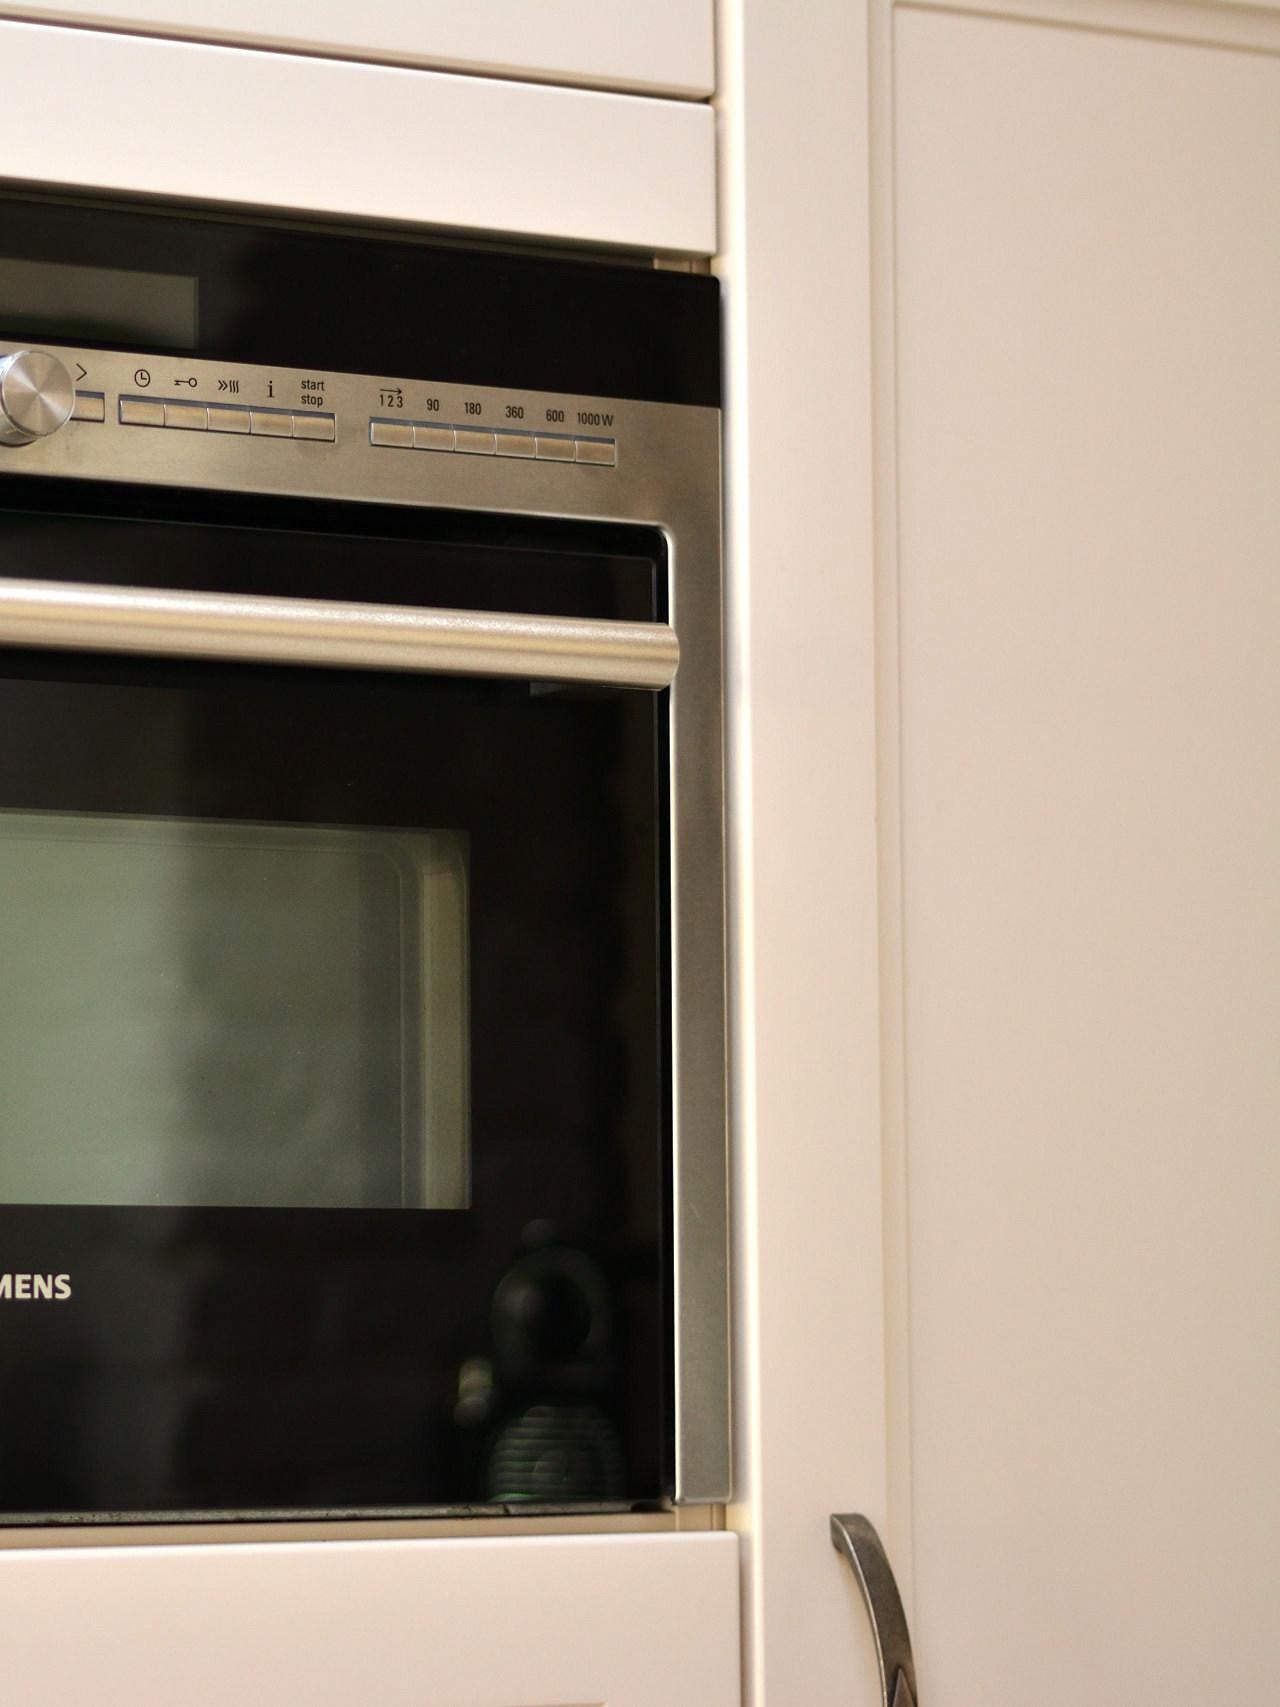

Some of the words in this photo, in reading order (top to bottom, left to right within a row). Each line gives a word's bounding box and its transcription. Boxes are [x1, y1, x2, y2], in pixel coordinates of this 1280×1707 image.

[301, 379, 325, 391] start
[301, 394, 324, 407] stop
[426, 398, 440, 411] 90
[464, 402, 482, 416] 180
[505, 406, 524, 419] 360
[546, 409, 565, 423] 600
